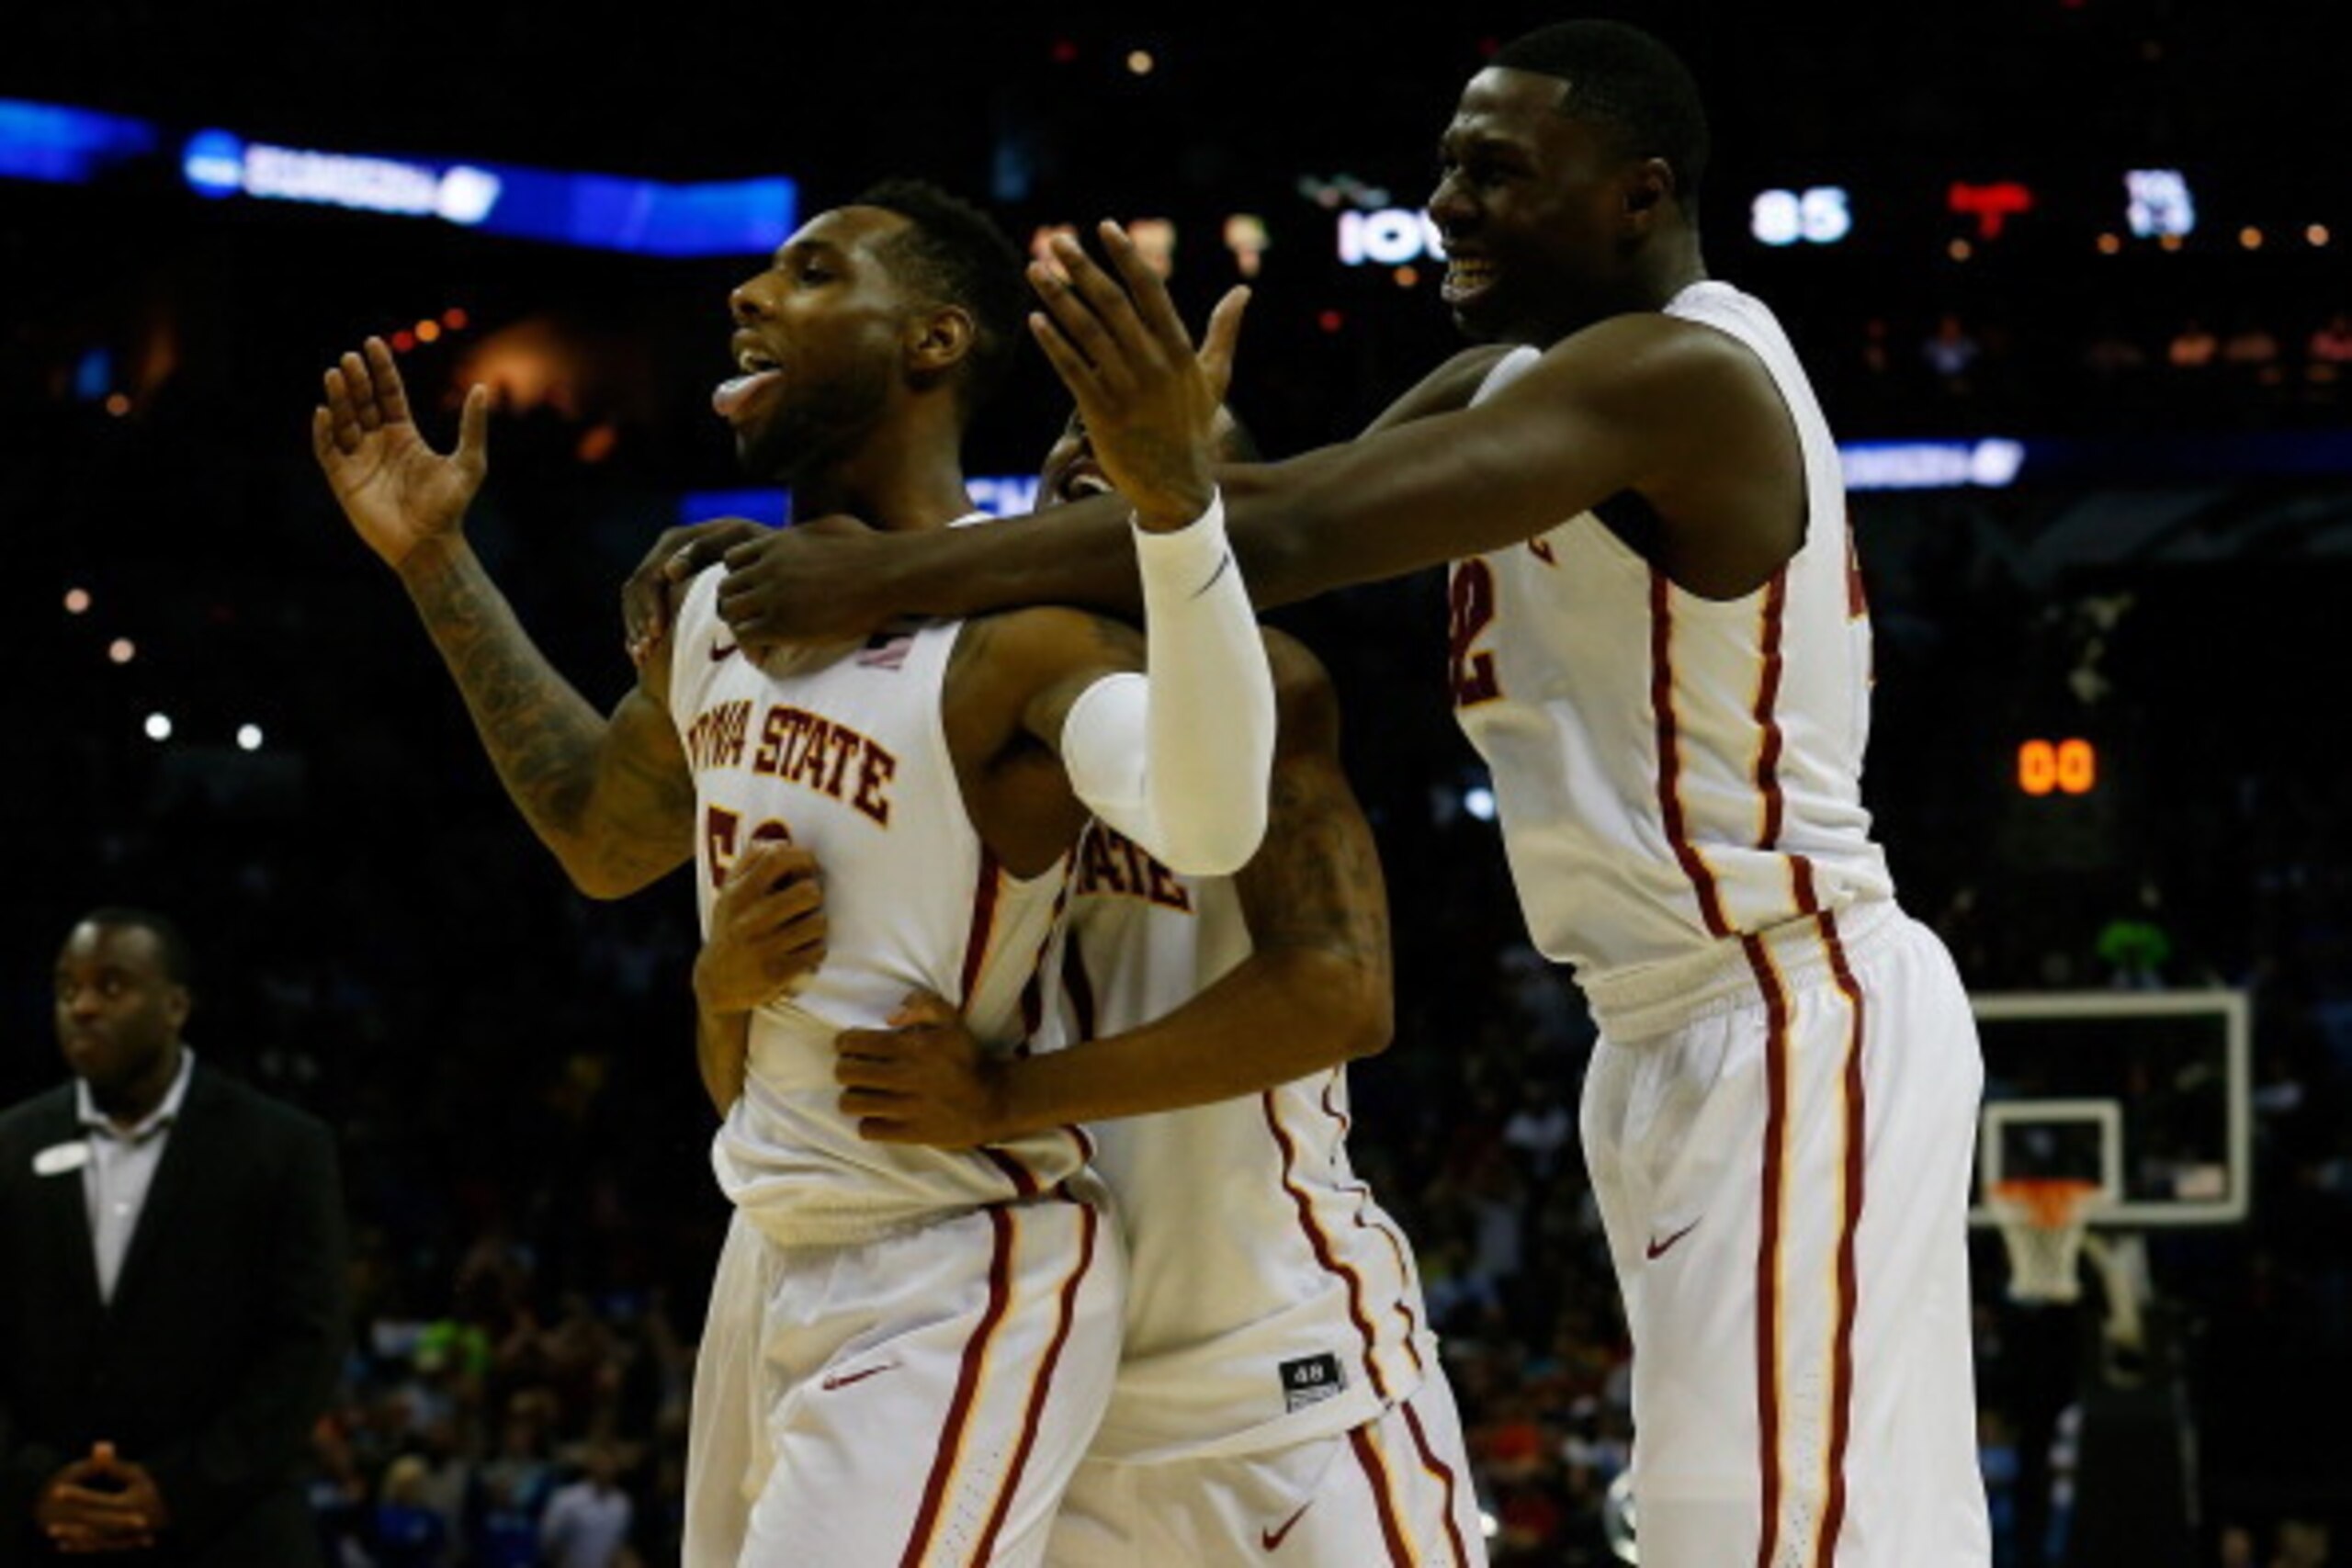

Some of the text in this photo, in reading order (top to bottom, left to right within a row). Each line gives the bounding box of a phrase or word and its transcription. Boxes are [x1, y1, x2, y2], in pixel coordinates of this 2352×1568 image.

[1751, 186, 1850, 245] 85
[752, 703, 897, 831] STATE
[2018, 738, 2095, 795] 00
[706, 803, 796, 891] 5
[1075, 818, 1197, 916] ATE
